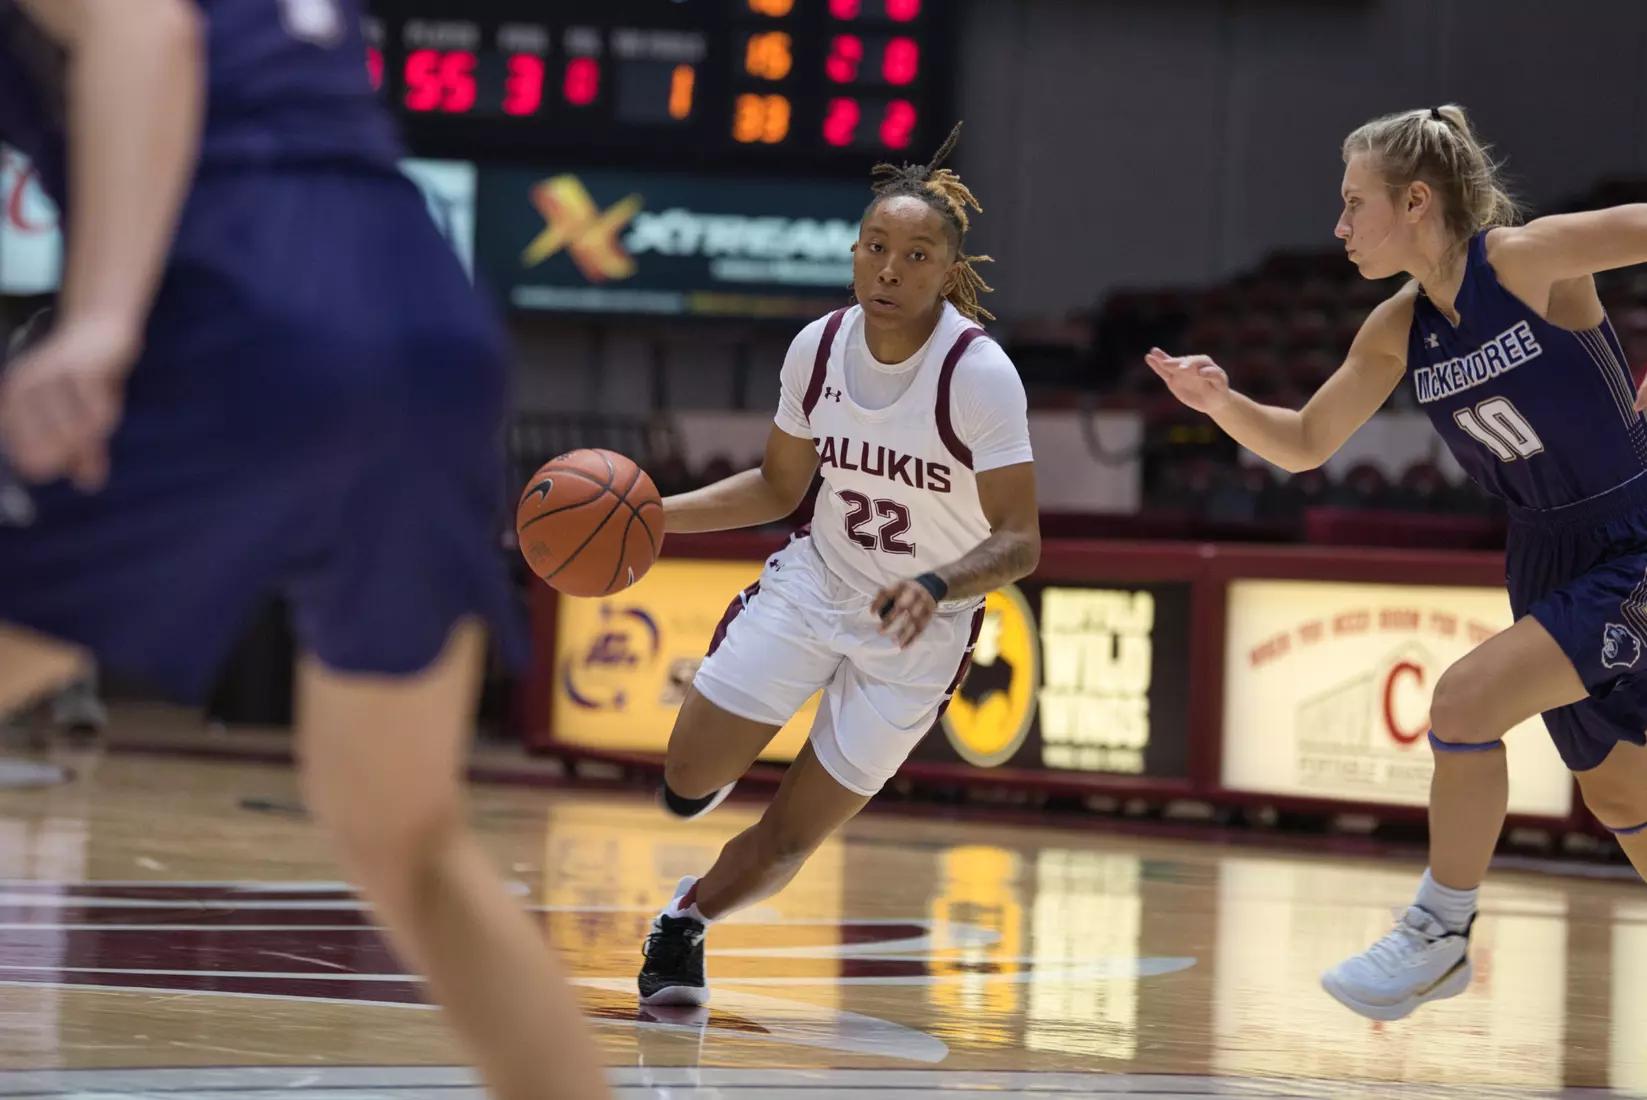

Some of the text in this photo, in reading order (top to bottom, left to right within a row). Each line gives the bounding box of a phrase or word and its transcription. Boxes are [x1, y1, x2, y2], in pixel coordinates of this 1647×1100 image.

[404, 49, 477, 112] 55
[502, 53, 545, 116] 3
[1453, 396, 1544, 463] 10
[836, 489, 916, 558] 22
